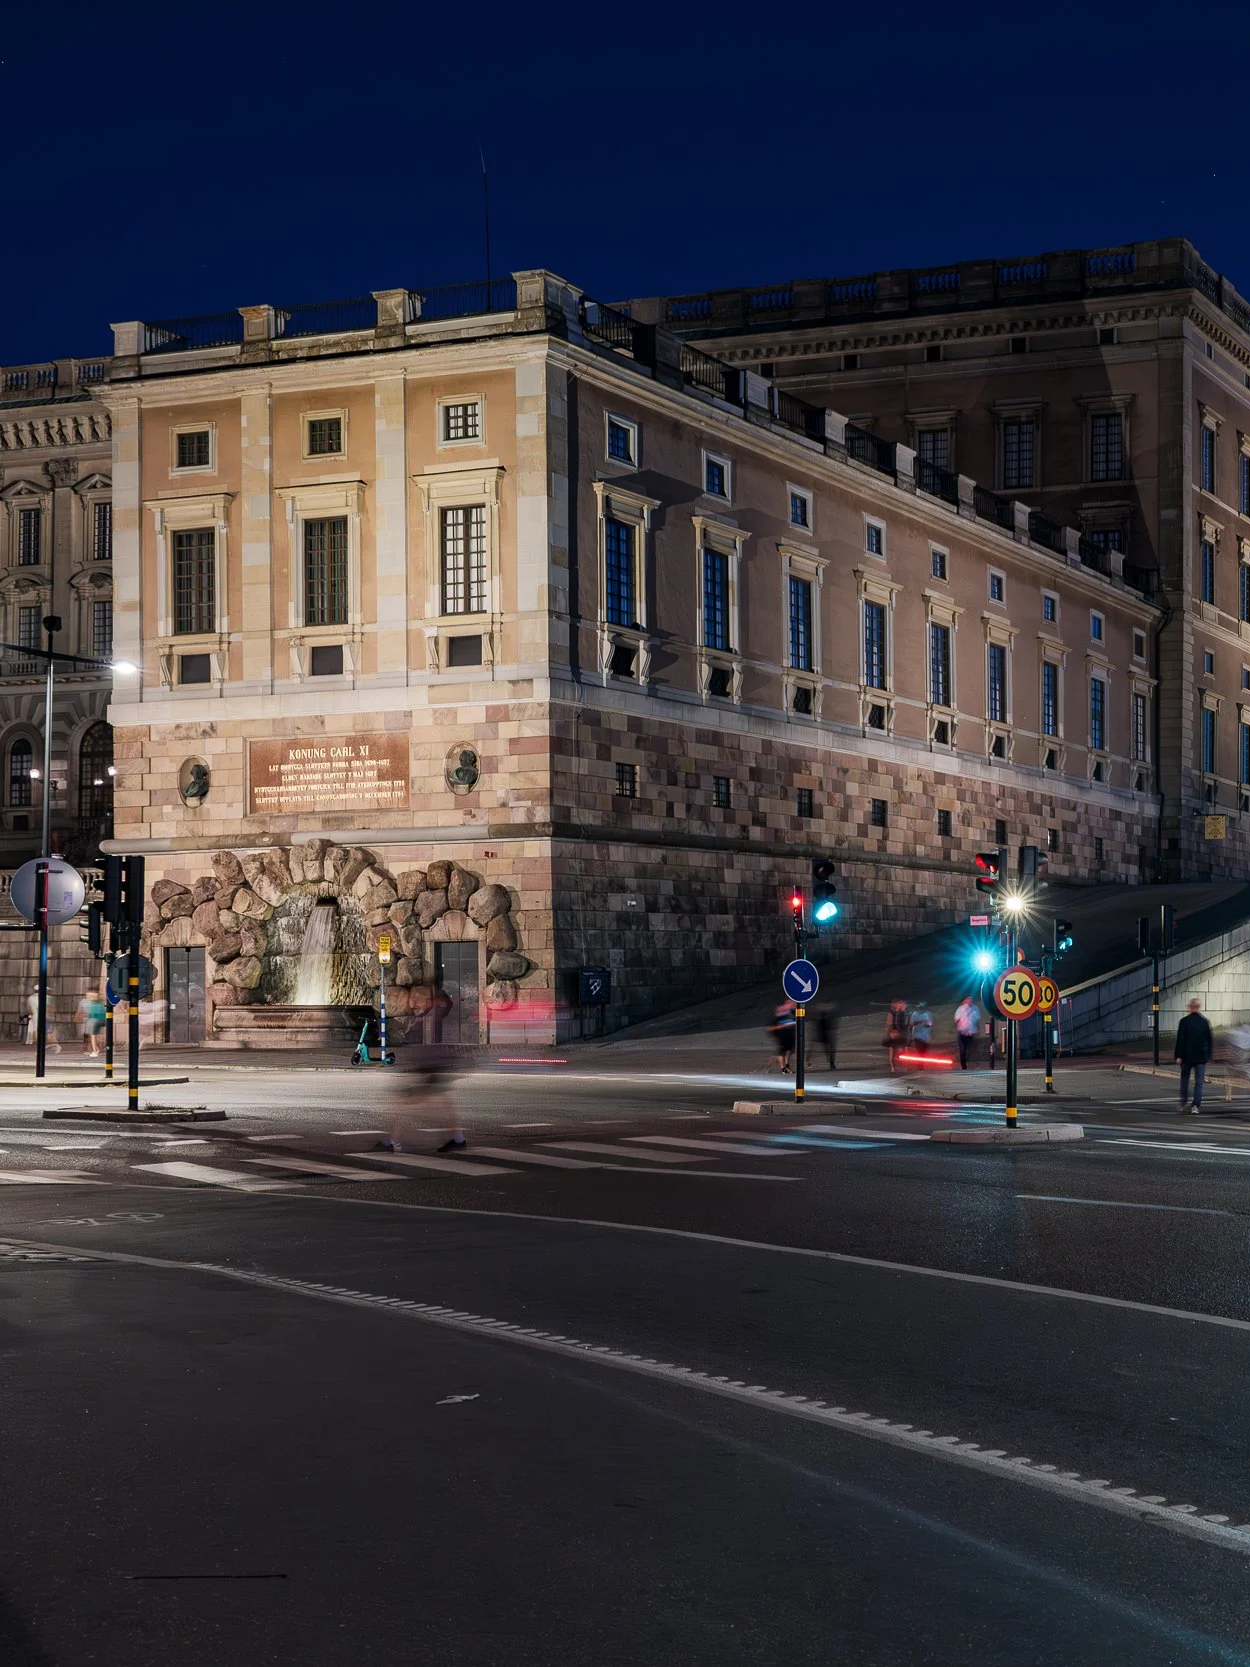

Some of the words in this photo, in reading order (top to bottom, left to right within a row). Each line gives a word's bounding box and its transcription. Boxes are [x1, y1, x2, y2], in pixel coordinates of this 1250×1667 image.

[289, 748, 326, 760] KONUNG
[330, 746, 355, 758] CARL
[359, 746, 369, 756] XI
[1003, 980, 1034, 1006] 50
